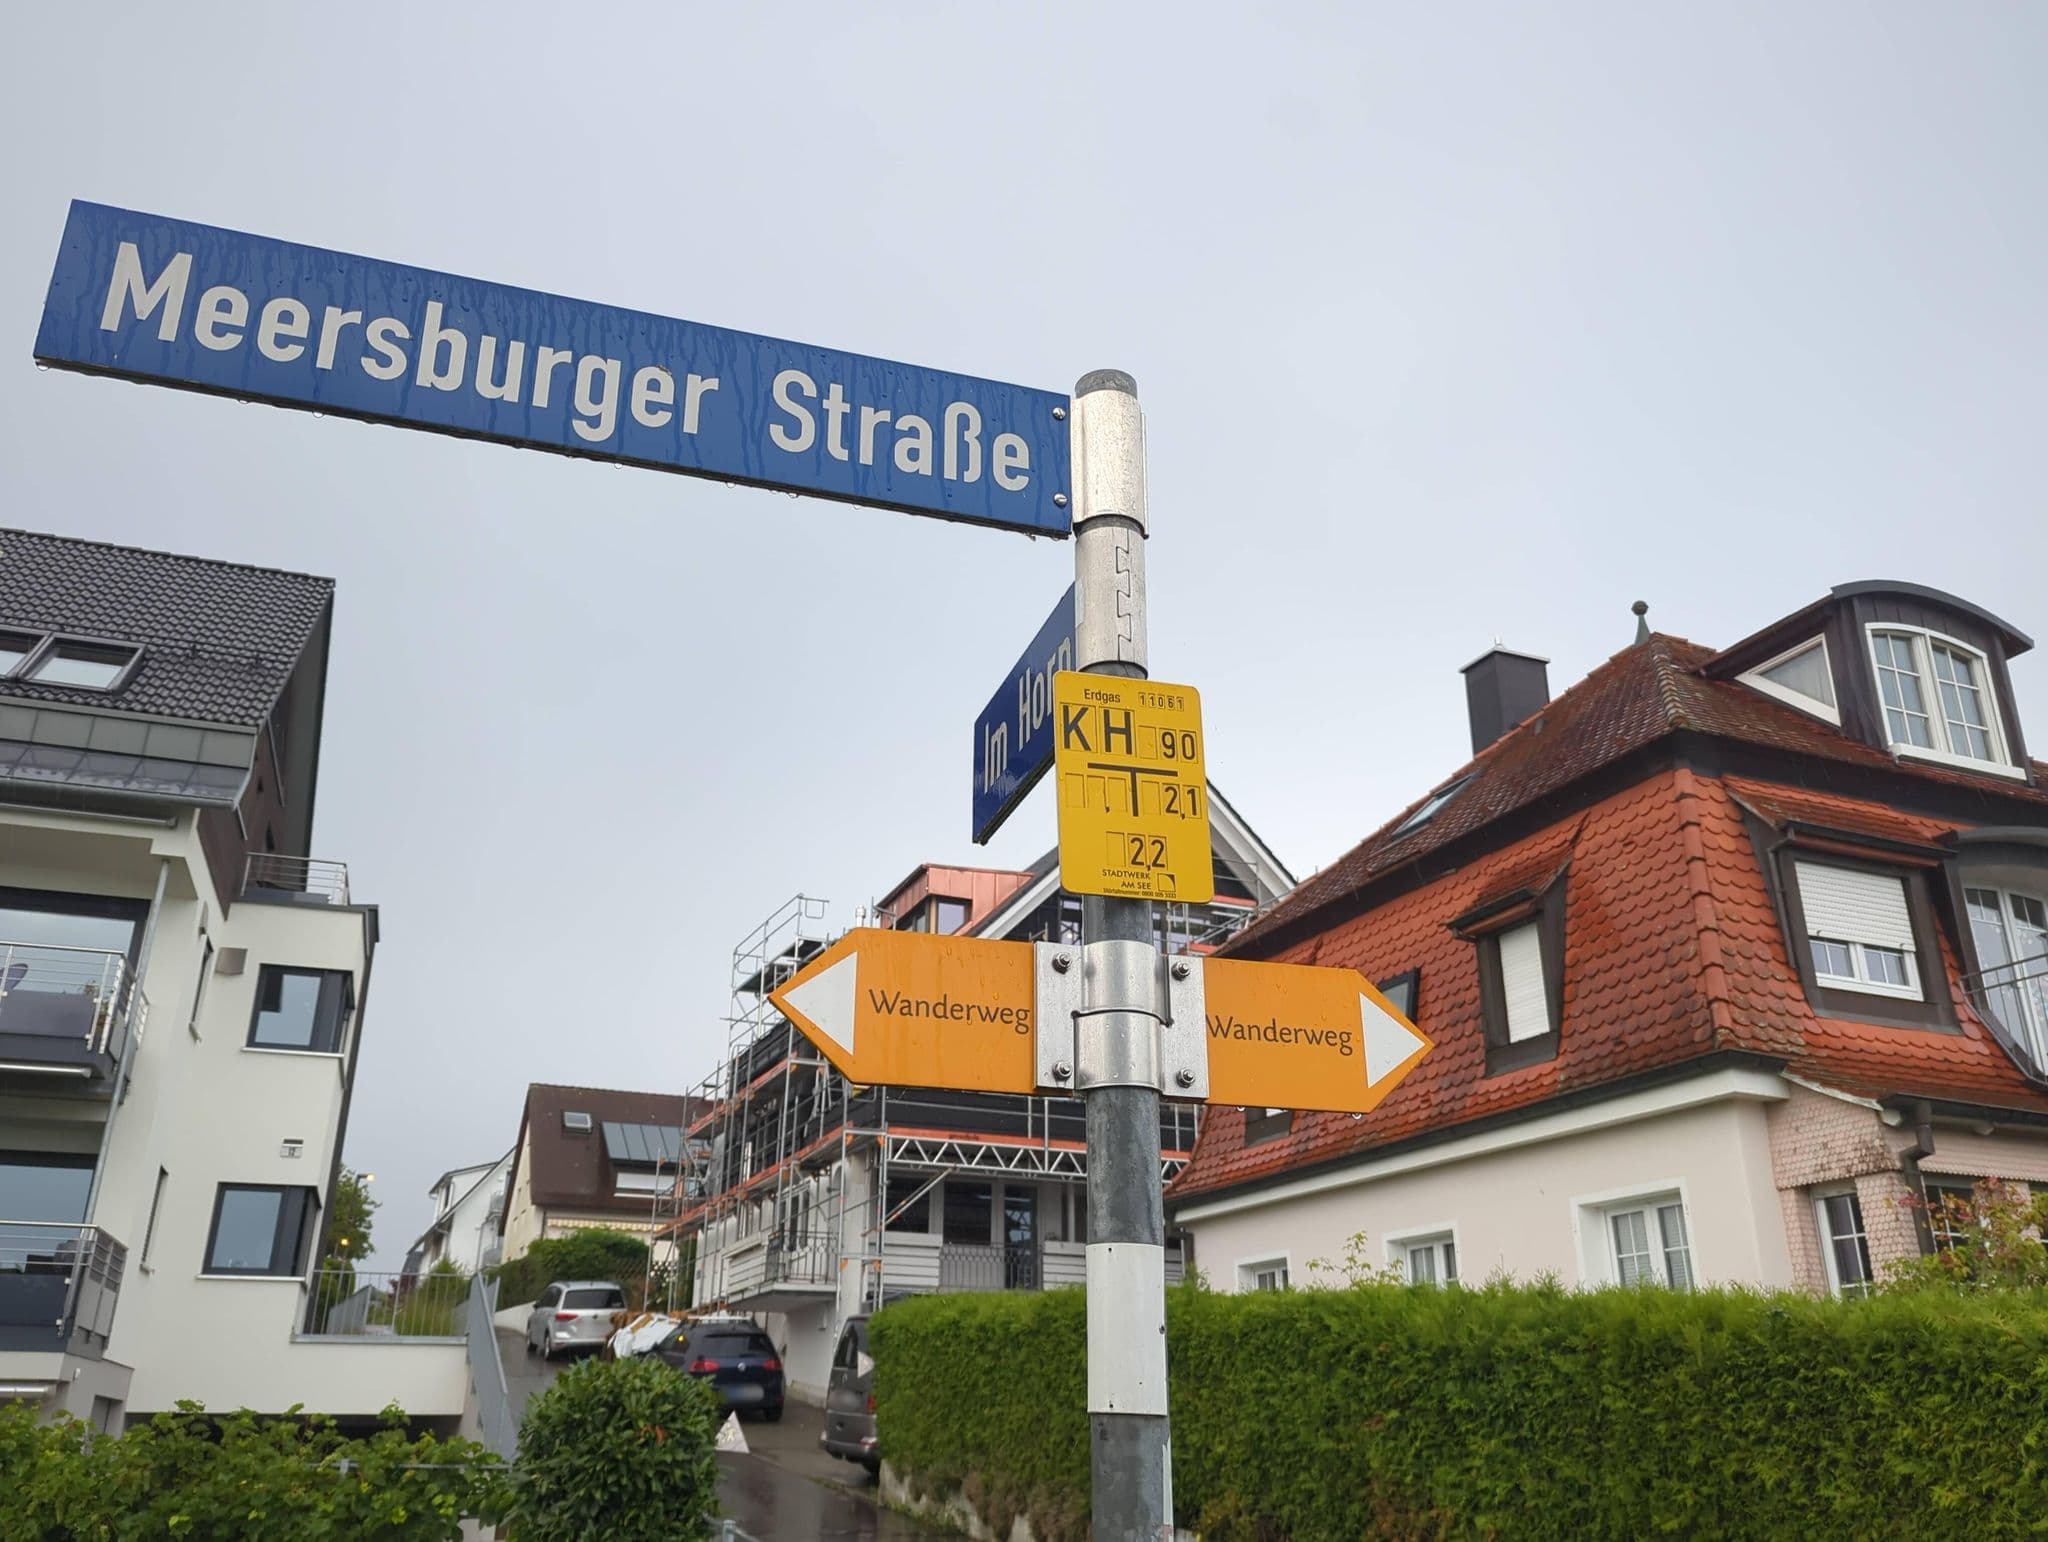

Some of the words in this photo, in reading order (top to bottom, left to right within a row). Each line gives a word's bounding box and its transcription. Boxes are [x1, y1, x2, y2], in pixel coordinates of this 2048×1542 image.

[100, 241, 720, 442] Meersburger
[769, 369, 1030, 492] Straße
[1083, 688, 1121, 704] Erdgas
[1140, 694, 1183, 710] 11061
[1062, 704, 1133, 755] KH
[1161, 731, 1196, 760] 90
[984, 721, 1008, 794] Im
[1163, 786, 1198, 820] 2,1
[1130, 837, 1166, 871] 2,2
[1102, 869, 1151, 880] STADTWERK
[1121, 881, 1135, 889] AM
[1137, 881, 1152, 890] SEE
[868, 988, 1031, 1035] Wanderweg
[1205, 1013, 1353, 1057] Wanderweg
